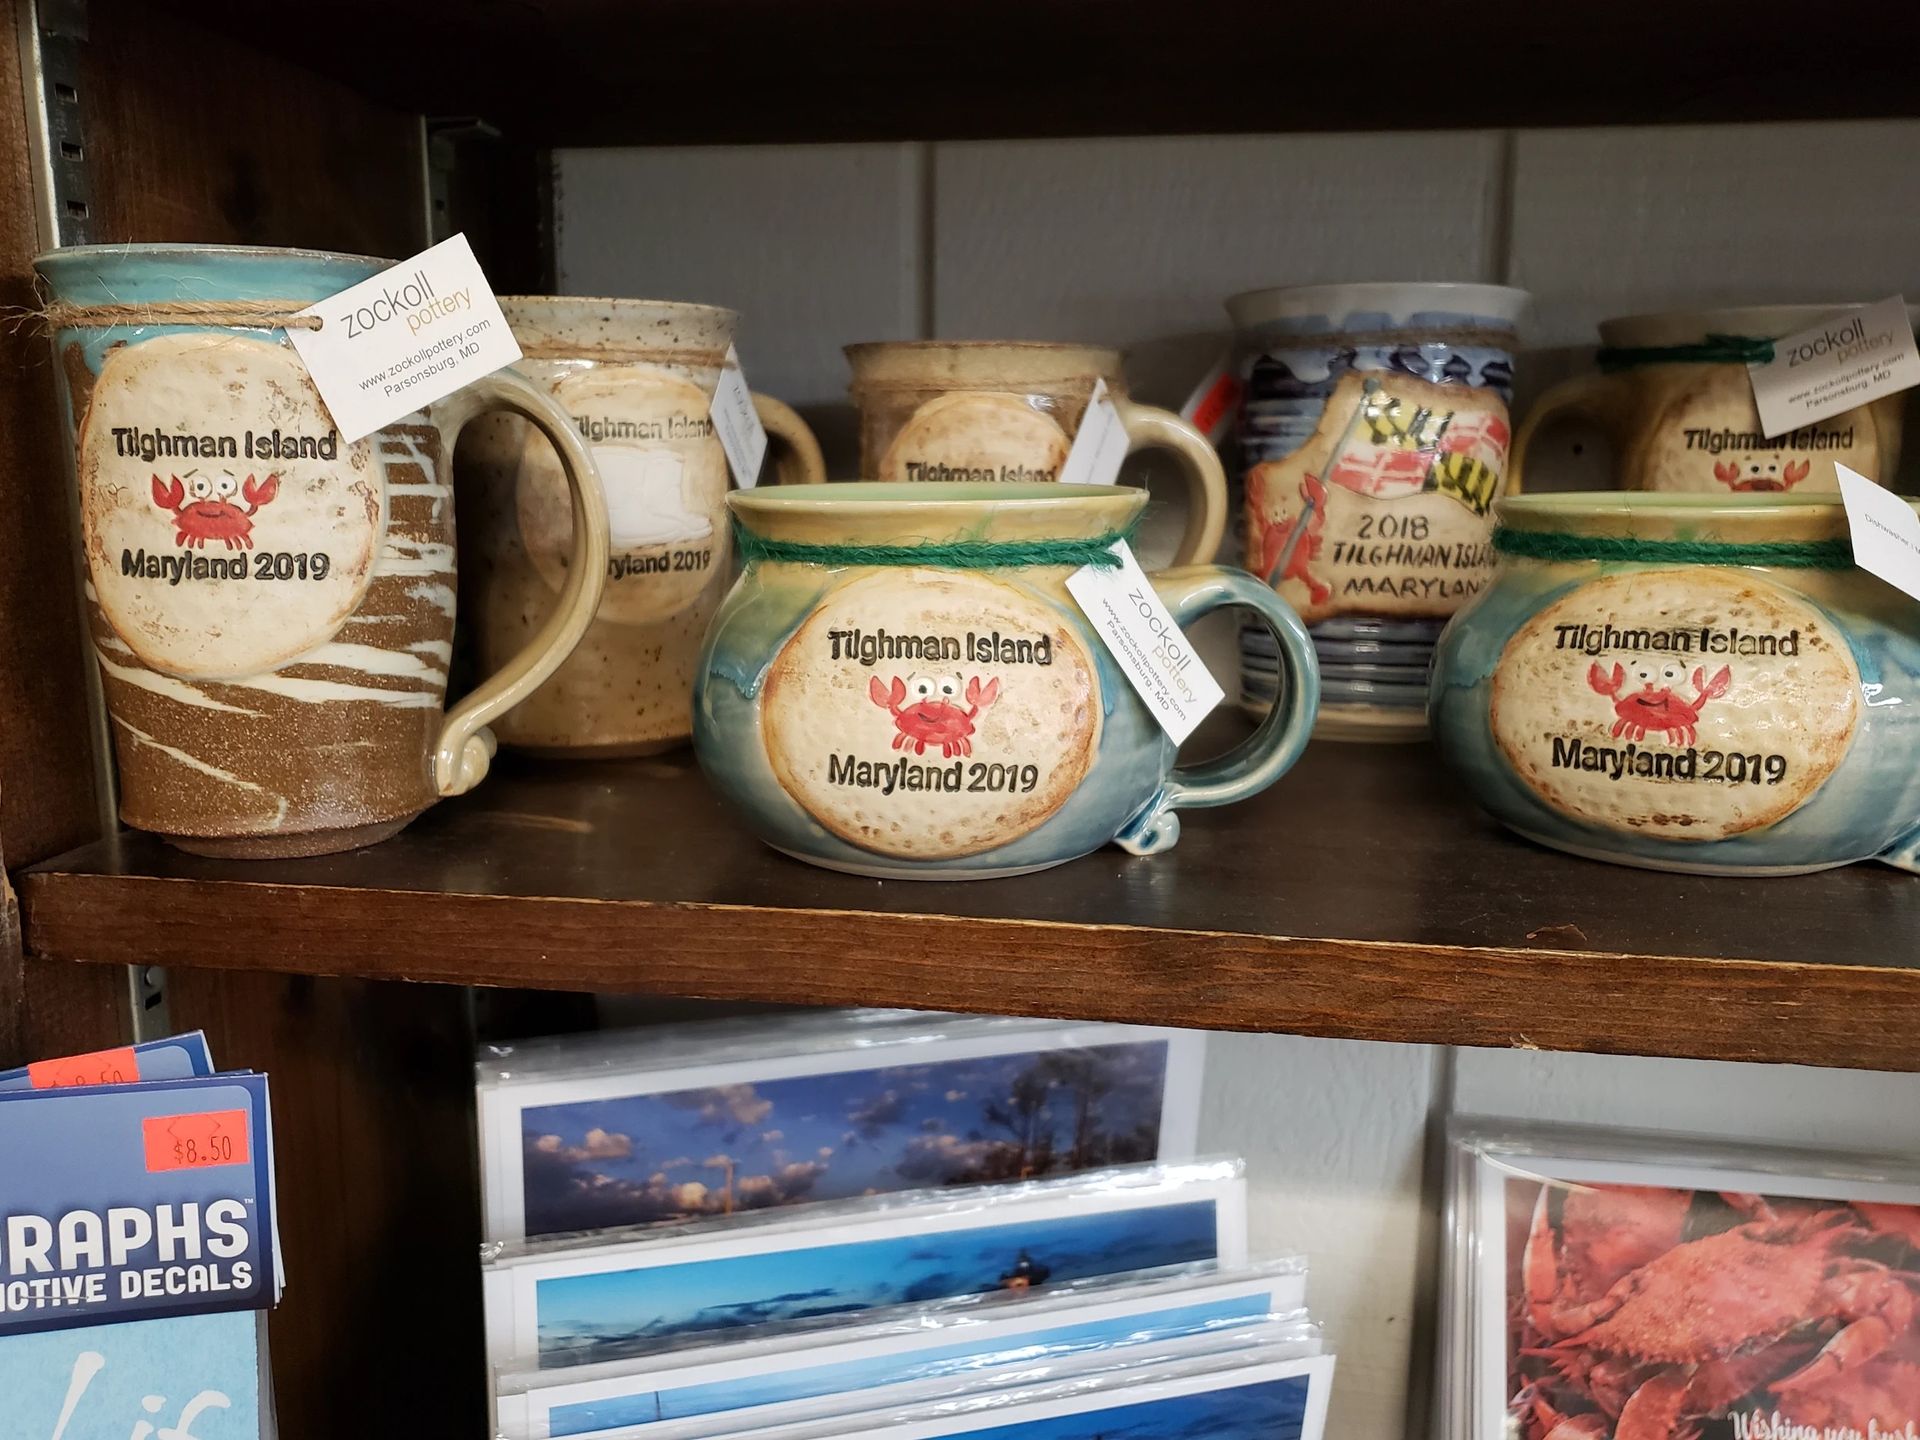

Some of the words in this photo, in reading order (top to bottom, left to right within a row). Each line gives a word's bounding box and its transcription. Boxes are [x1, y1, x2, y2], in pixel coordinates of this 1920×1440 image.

[340, 270, 435, 339] zockoll
[406, 287, 472, 336] pottery
[358, 318, 491, 391] www.zockollpottery.com
[459, 341, 481, 361] MD
[1787, 317, 1865, 368] zockoll
[1838, 329, 1894, 365] pottery
[1873, 369, 1892, 384] MD
[112, 427, 237, 462] Tilghman
[245, 429, 338, 460] Island
[1789, 427, 1854, 451] Island
[906, 461, 995, 482] Tilghman
[1000, 464, 1057, 482] Island
[1357, 514, 1430, 541] 2018
[122, 548, 248, 586] Maryland
[254, 551, 330, 581] 2019
[607, 551, 671, 581] ryland
[673, 550, 711, 572] 2019
[1332, 541, 1452, 569] TILGHMAN
[1343, 576, 1488, 599] MARYLAN
[827, 628, 961, 666] Tilghman
[967, 632, 1052, 665] Island
[1128, 588, 1192, 672] zockoll
[1554, 624, 1691, 656] Tilghman
[1699, 628, 1799, 656] Island
[1102, 597, 1187, 722] www.zockollpottery.com
[1152, 645, 1198, 705] pottery
[1154, 691, 1170, 711] MD
[828, 754, 963, 795] Maryland
[967, 763, 1039, 793] 2019
[1552, 737, 1697, 781] Maryland
[1703, 750, 1788, 785] 2019
[173, 1136, 232, 1165] $8.50
[0, 1199, 249, 1276] RAPHS
[0, 1272, 107, 1313] OTIVE
[120, 1261, 253, 1299] DECALS
